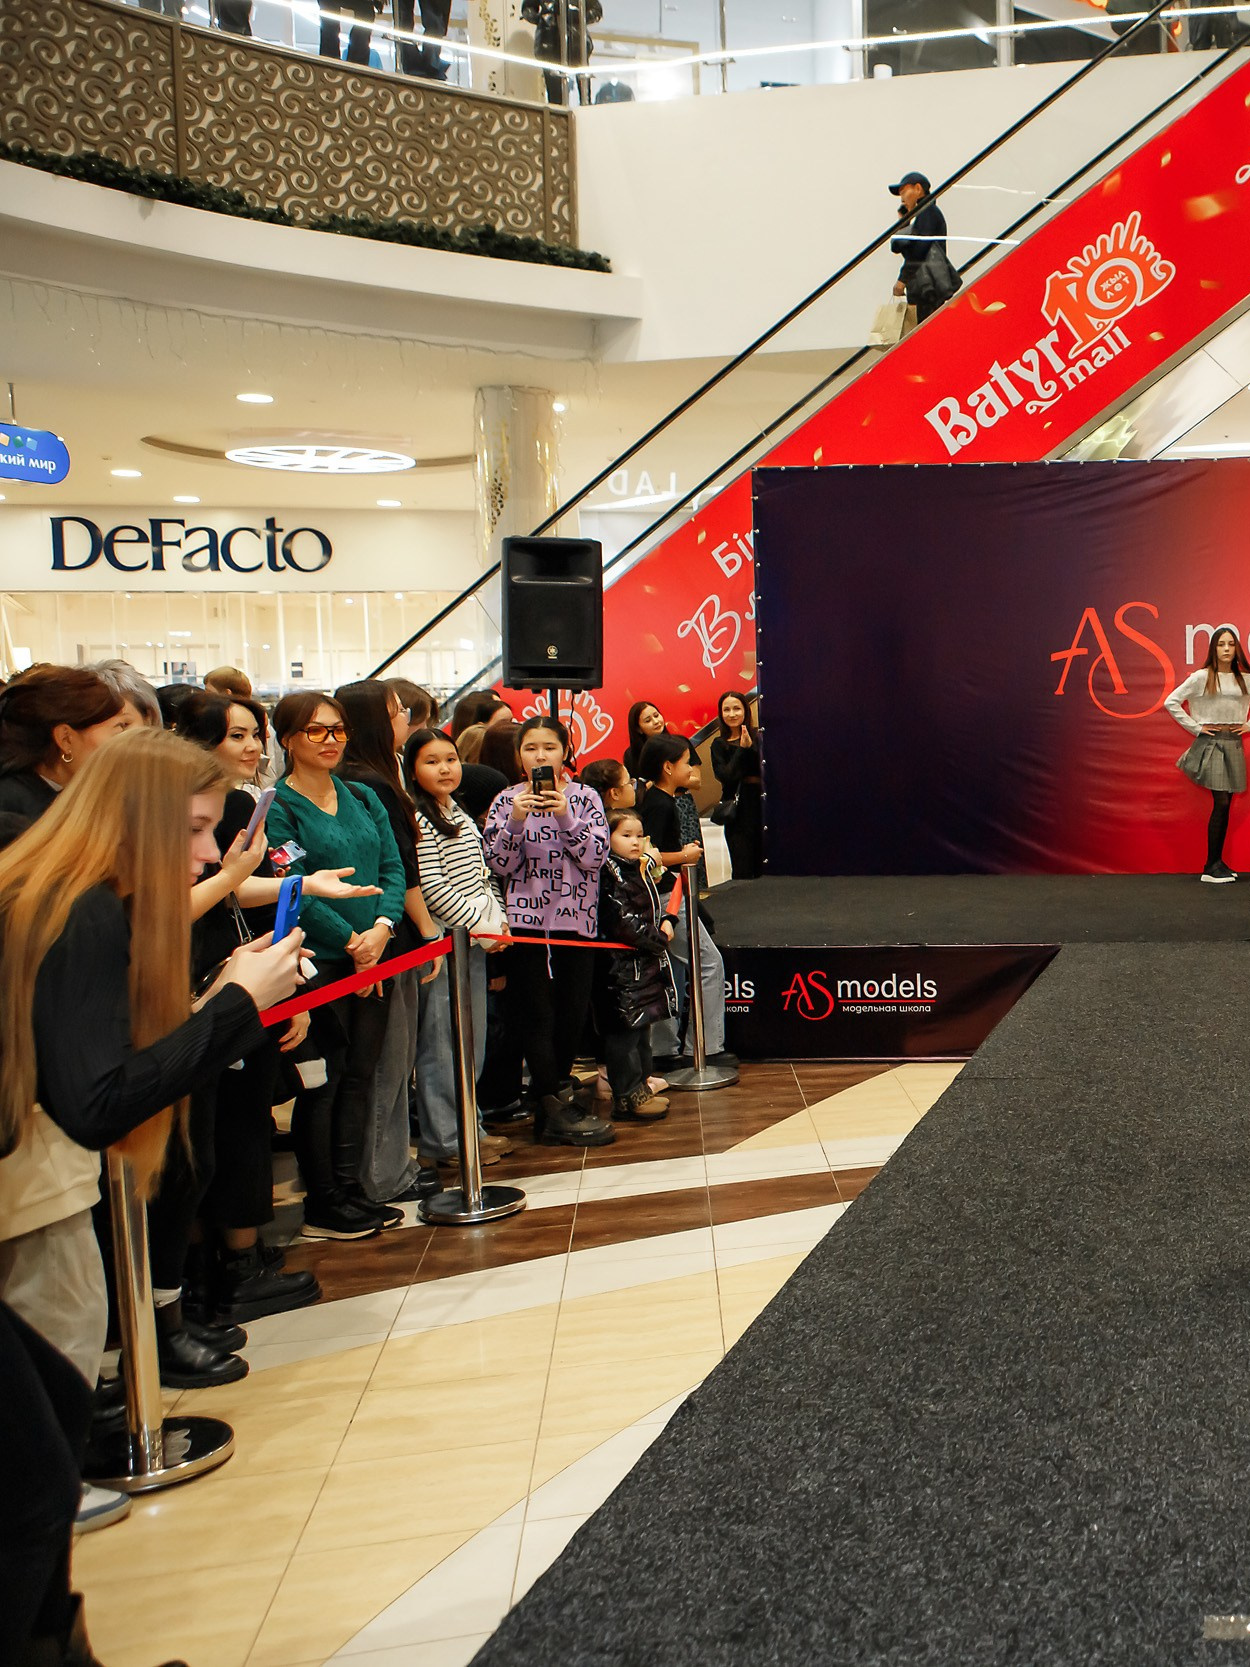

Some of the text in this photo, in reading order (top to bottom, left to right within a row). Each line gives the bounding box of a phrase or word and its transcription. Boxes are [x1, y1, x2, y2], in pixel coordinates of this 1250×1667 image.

[1060, 326, 1132, 391] mall
[924, 330, 1062, 456] Batyr
[29, 458, 57, 474] мир
[49, 516, 332, 573] DeFacto
[1050, 601, 1175, 719] AS
[724, 1005, 750, 1013] кола
[781, 970, 938, 1021] AS models
[842, 1004, 932, 1014] модельная школа
